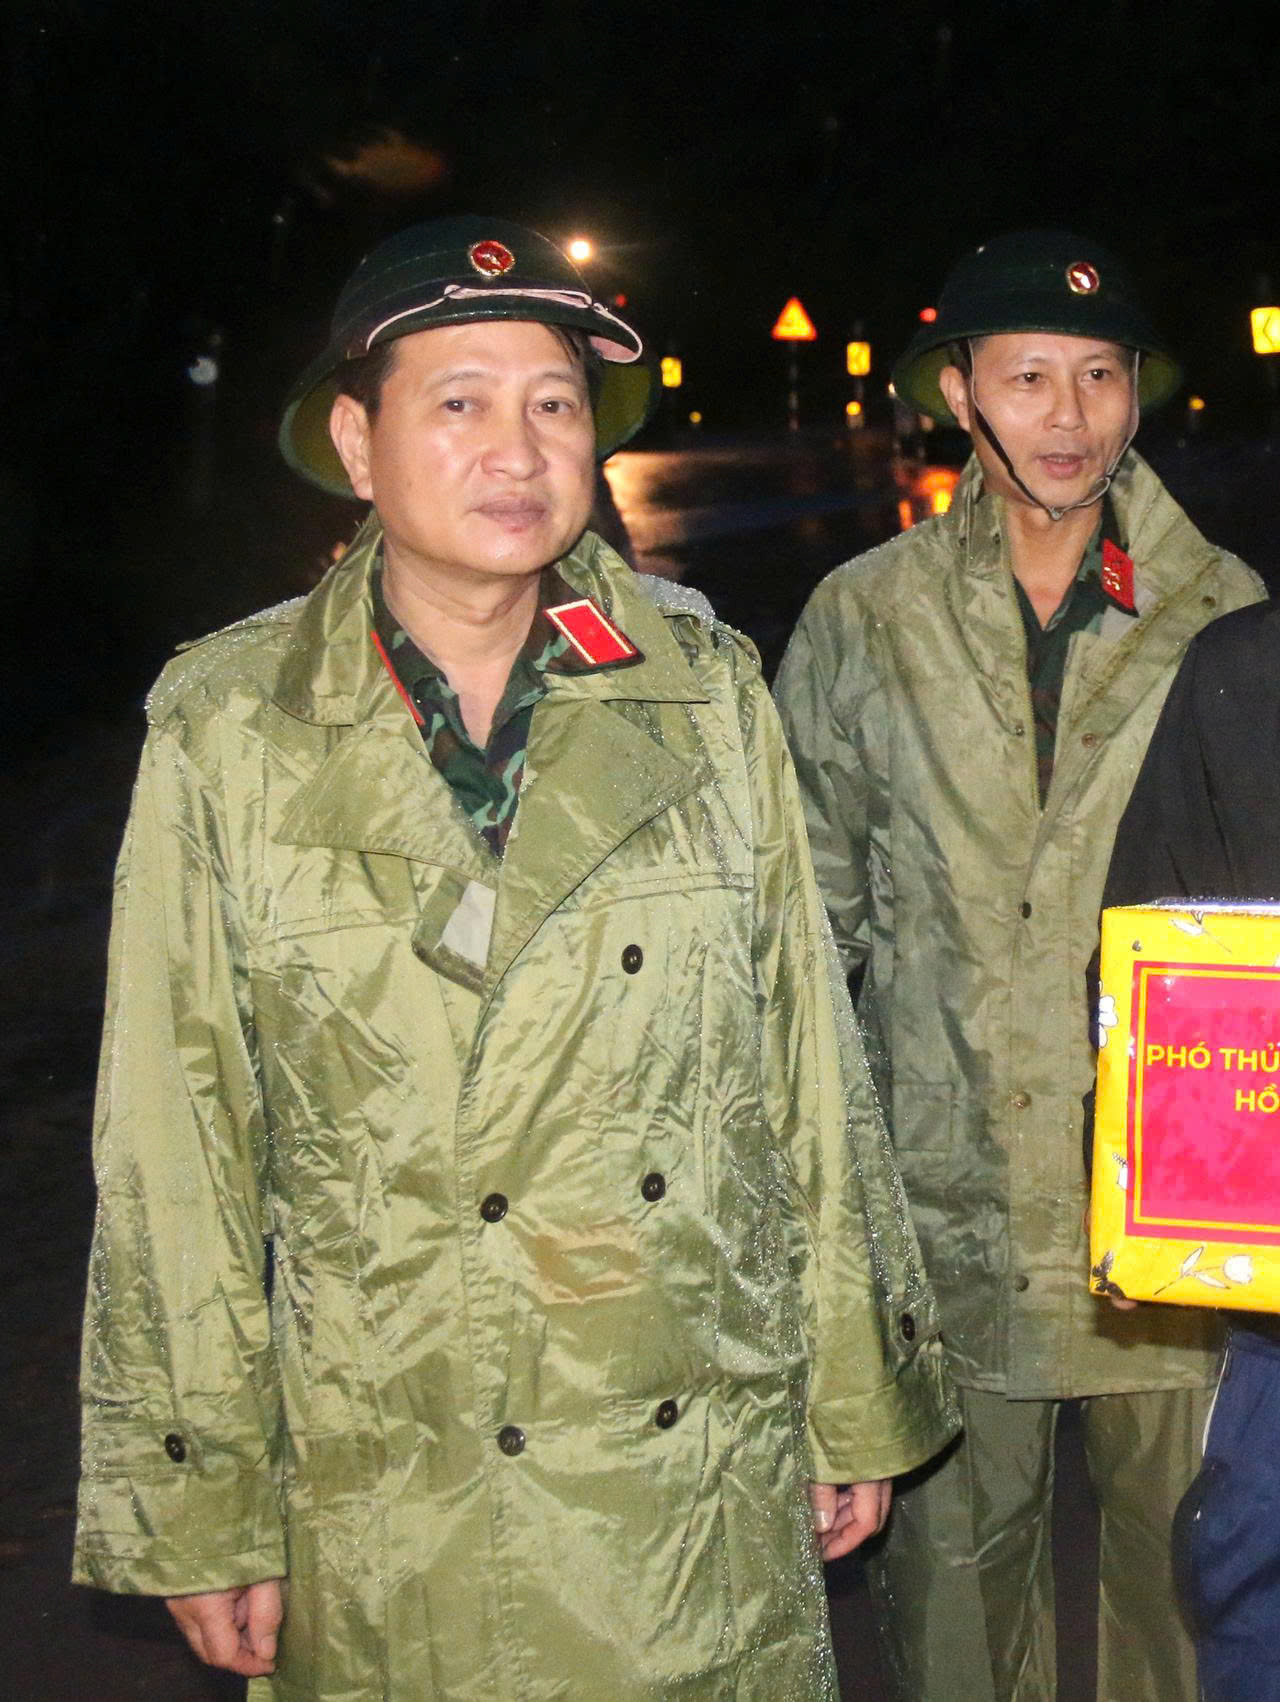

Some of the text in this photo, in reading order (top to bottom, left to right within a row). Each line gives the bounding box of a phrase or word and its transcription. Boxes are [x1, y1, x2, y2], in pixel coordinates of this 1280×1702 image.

[1146, 1041, 1212, 1069] PHÓ
[1219, 1042, 1280, 1073] THỦ
[1234, 1083, 1280, 1114] HỒ
